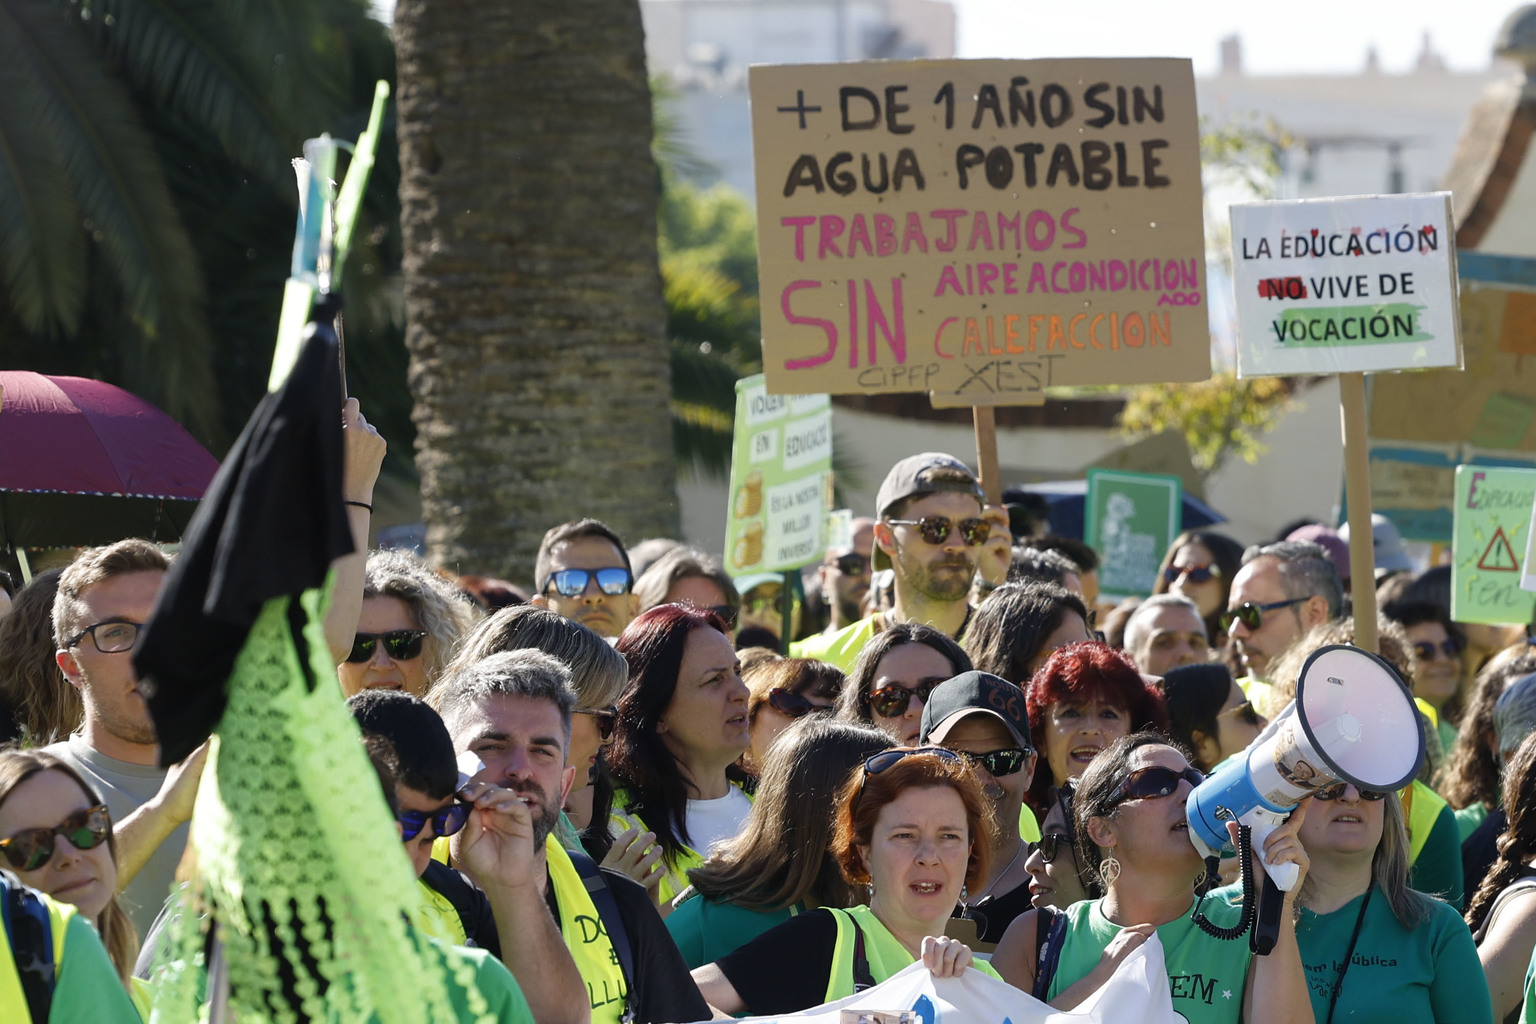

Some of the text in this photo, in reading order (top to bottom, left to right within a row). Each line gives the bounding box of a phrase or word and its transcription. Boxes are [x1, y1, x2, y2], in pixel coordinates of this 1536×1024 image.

[839, 85, 916, 134] DE
[933, 82, 954, 130] 1
[972, 77, 1075, 129] AÑO
[1083, 83, 1165, 129] SIN
[783, 139, 1170, 198] AGUA POTABLE
[781, 208, 1088, 263] TRABAJAMOS
[1242, 224, 1438, 260] LA EDUCACIÓN
[934, 258, 1200, 298] AIRE ACONDICION
[1267, 272, 1414, 301] NO VIVE DE
[781, 278, 906, 371] SIN
[934, 311, 1172, 360] CALEFACCION
[1272, 309, 1414, 342] VOCACIÓN
[857, 354, 1066, 395] CIPFP XEST
[988, 688, 1021, 721] 66
[1351, 953, 1397, 967] ública
[588, 979, 627, 1010] LLU
